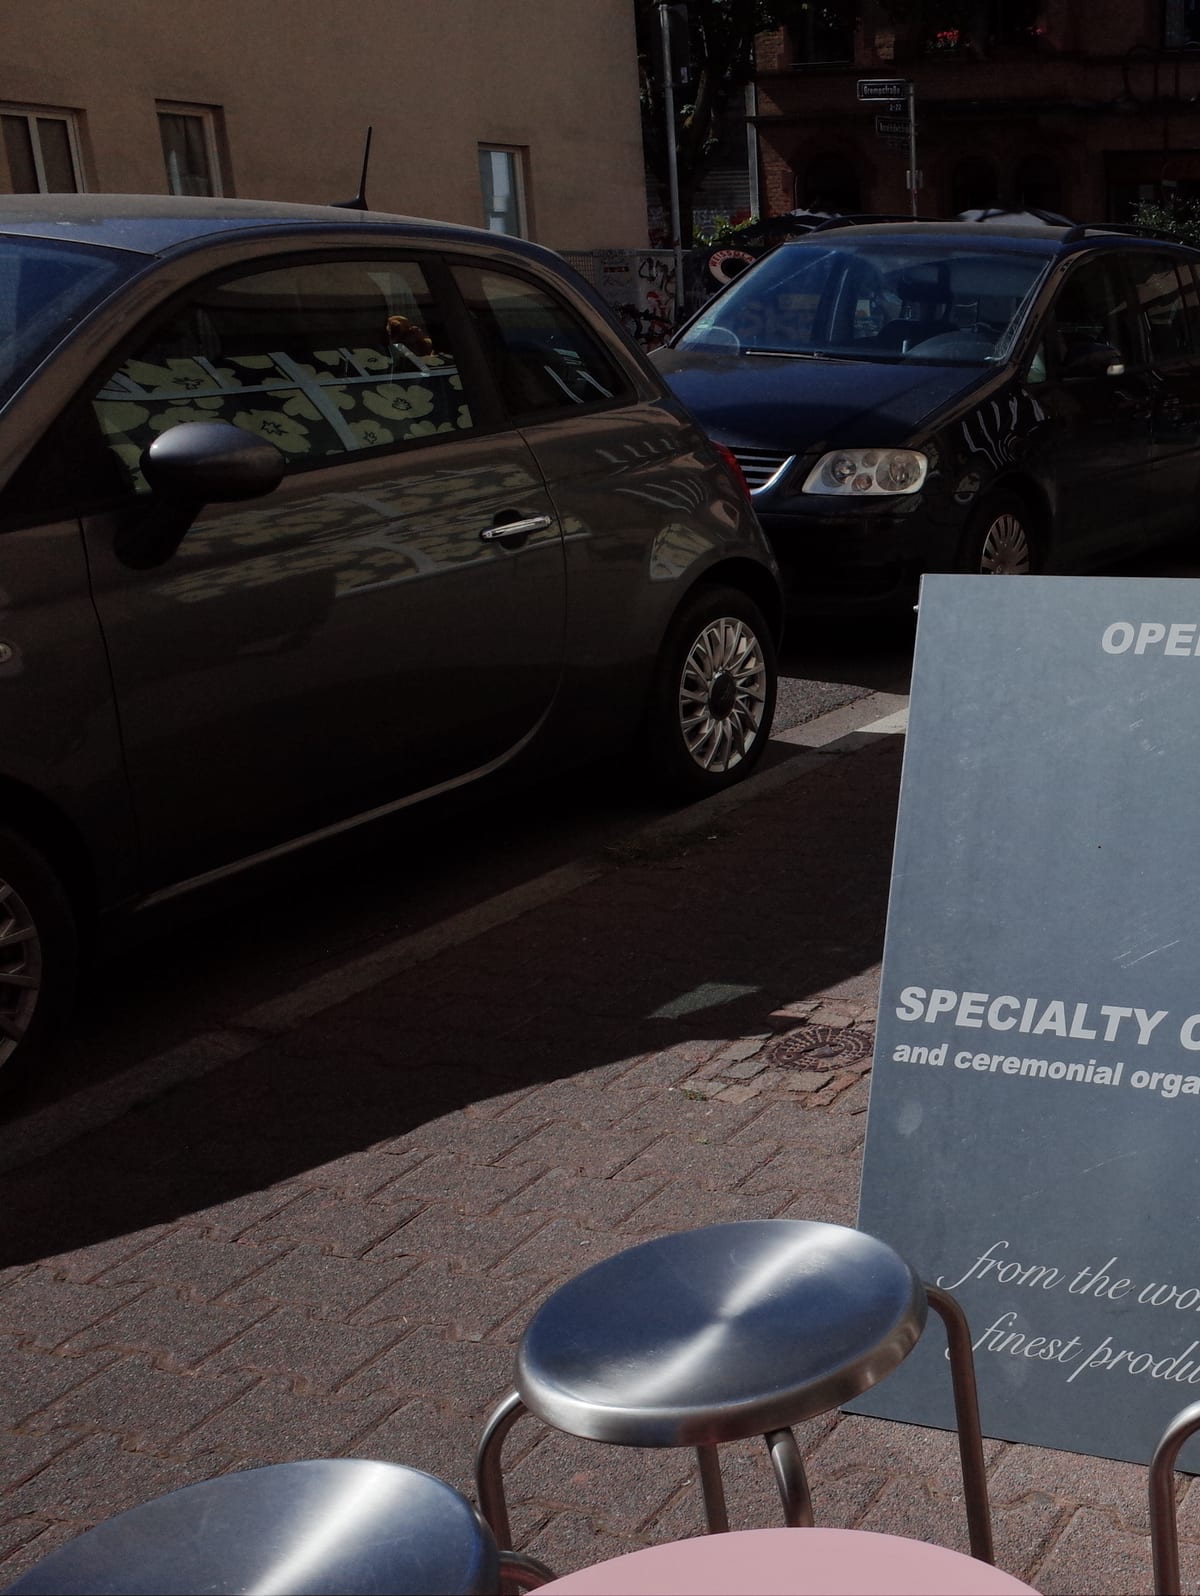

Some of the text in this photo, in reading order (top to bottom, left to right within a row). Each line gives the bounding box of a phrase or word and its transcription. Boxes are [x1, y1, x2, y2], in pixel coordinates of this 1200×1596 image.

[710, 249, 756, 267] WEISSGLA
[895, 985, 1169, 1046] SPECIALTY
[892, 1043, 949, 1067] and
[953, 1050, 1125, 1086] ceremonial
[936, 1240, 1066, 1290] from
[1068, 1256, 1137, 1300] the
[944, 1311, 1084, 1363] finest
